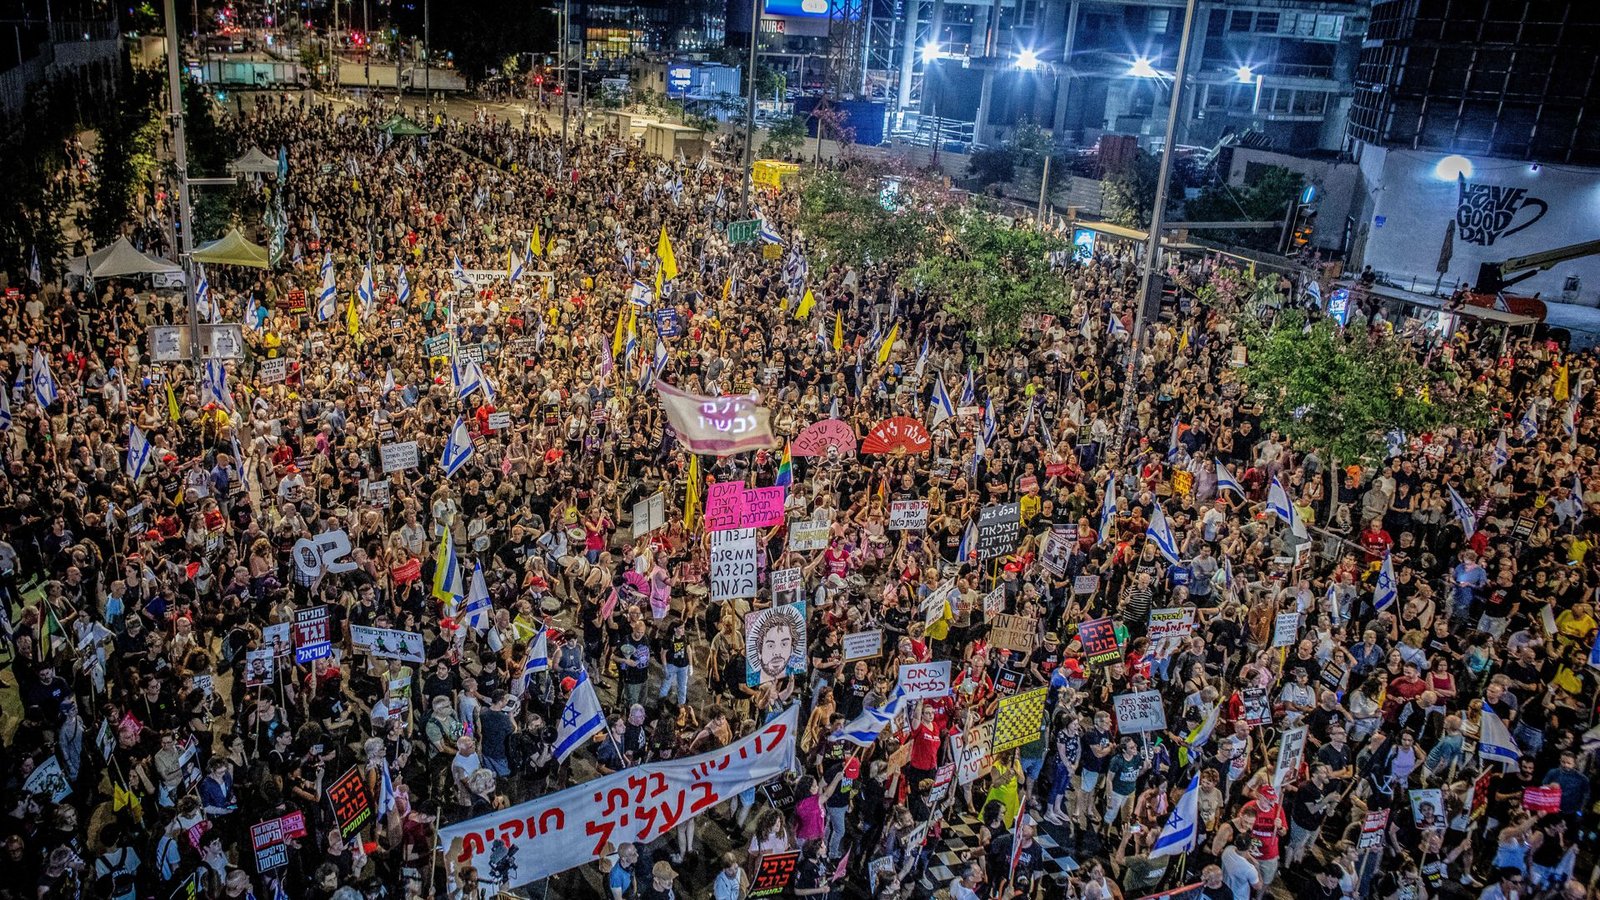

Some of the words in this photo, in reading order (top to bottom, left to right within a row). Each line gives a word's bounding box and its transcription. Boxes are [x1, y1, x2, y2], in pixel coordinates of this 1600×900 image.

[1457, 204, 1513, 231] GOOD
[1460, 226, 1503, 246] DAY
[799, 425, 828, 450] שלום
[712, 484, 737, 498] העם
[742, 490, 759, 503] גבר
[714, 497, 738, 507] רוצה
[708, 515, 735, 528] בבית
[981, 532, 1018, 547] המדינה
[711, 548, 754, 565] ממשלה
[712, 564, 754, 579] בוגדת
[711, 580, 754, 597] בעמה
[298, 608, 326, 621] נתניהו
[994, 614, 1009, 628] IN
[300, 624, 325, 641] נגד
[1083, 623, 1114, 639] ביבי
[1009, 631, 1035, 648] TRUST
[1085, 637, 1117, 652] בוגד
[299, 645, 330, 661] ישראל
[907, 668, 928, 679] אם
[928, 667, 945, 678] עם
[963, 745, 981, 762] היום
[331, 775, 363, 803] ביבי
[594, 771, 669, 816] בלתי
[337, 791, 367, 820] בוגד
[586, 781, 719, 856] בעליל
[457, 807, 565, 863] חוקית
[763, 860, 796, 874] ביבי
[758, 873, 790, 887] בוגד
